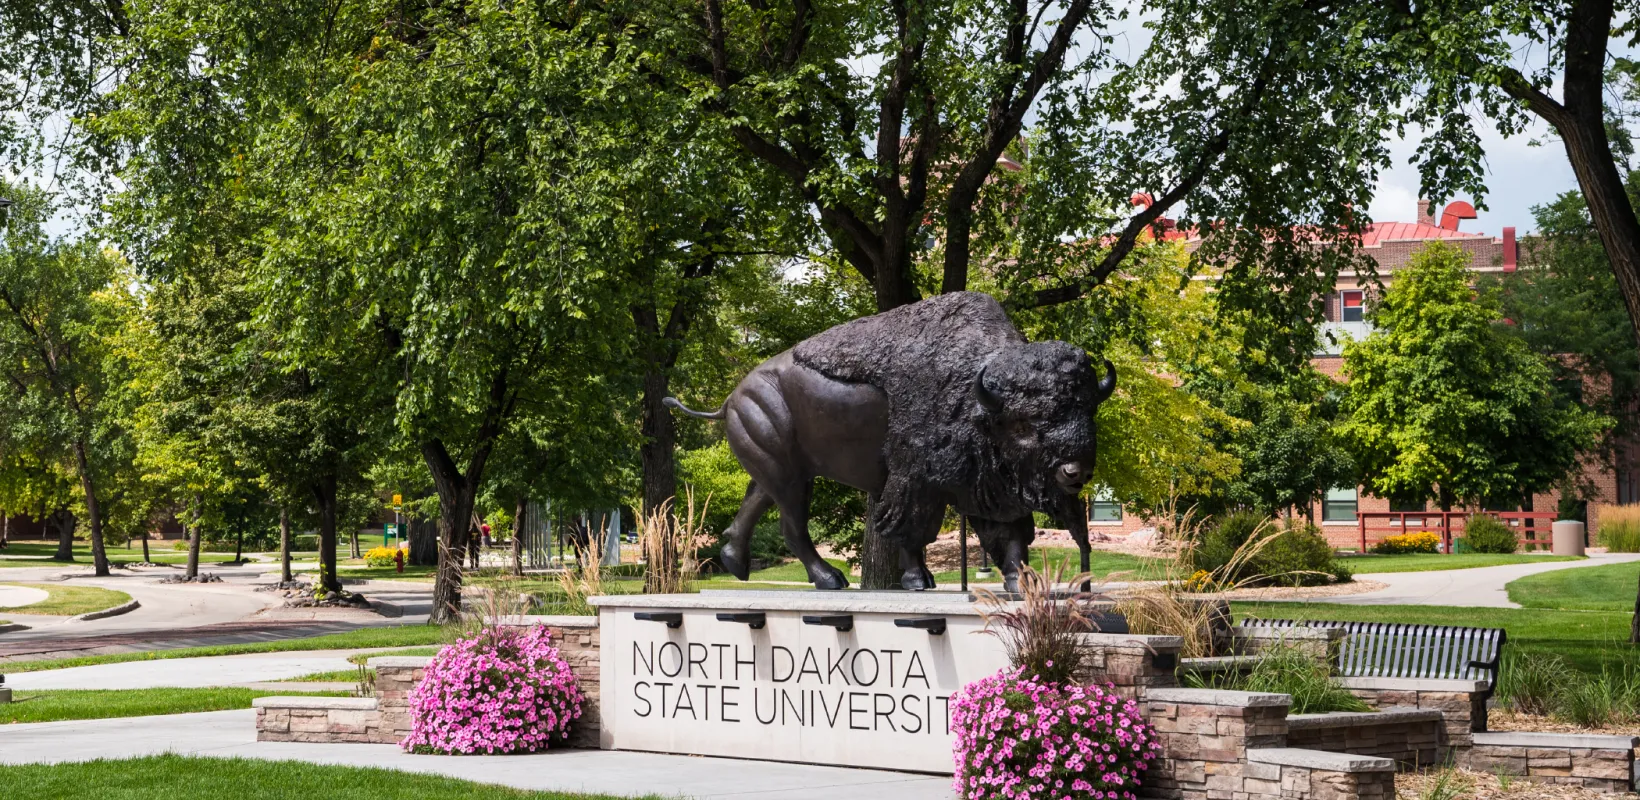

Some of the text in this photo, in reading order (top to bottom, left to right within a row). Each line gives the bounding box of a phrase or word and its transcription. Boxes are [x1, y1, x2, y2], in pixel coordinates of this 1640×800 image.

[633, 641, 930, 689] NORTH DAKOTA
[633, 681, 952, 735] STATE UNIVERSIT
